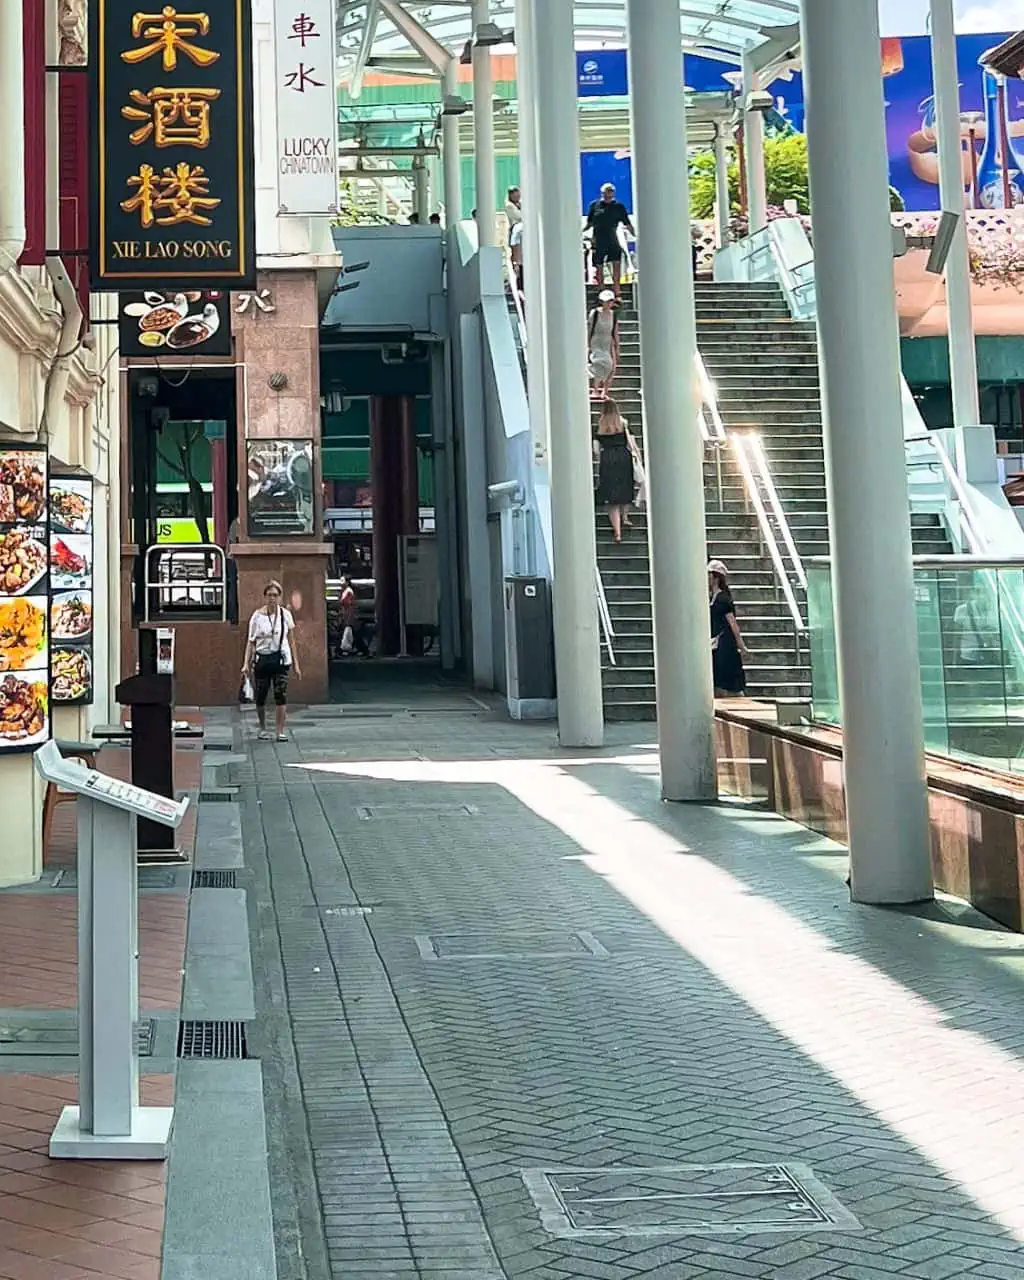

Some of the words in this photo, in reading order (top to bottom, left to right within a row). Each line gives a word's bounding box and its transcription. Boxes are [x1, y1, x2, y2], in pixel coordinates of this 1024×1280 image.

[284, 137, 330, 157] LUCKY
[280, 156, 334, 175] CHINATOWN
[112, 241, 141, 259] XIE
[145, 241, 179, 259] LAO
[183, 240, 232, 258] SONG
